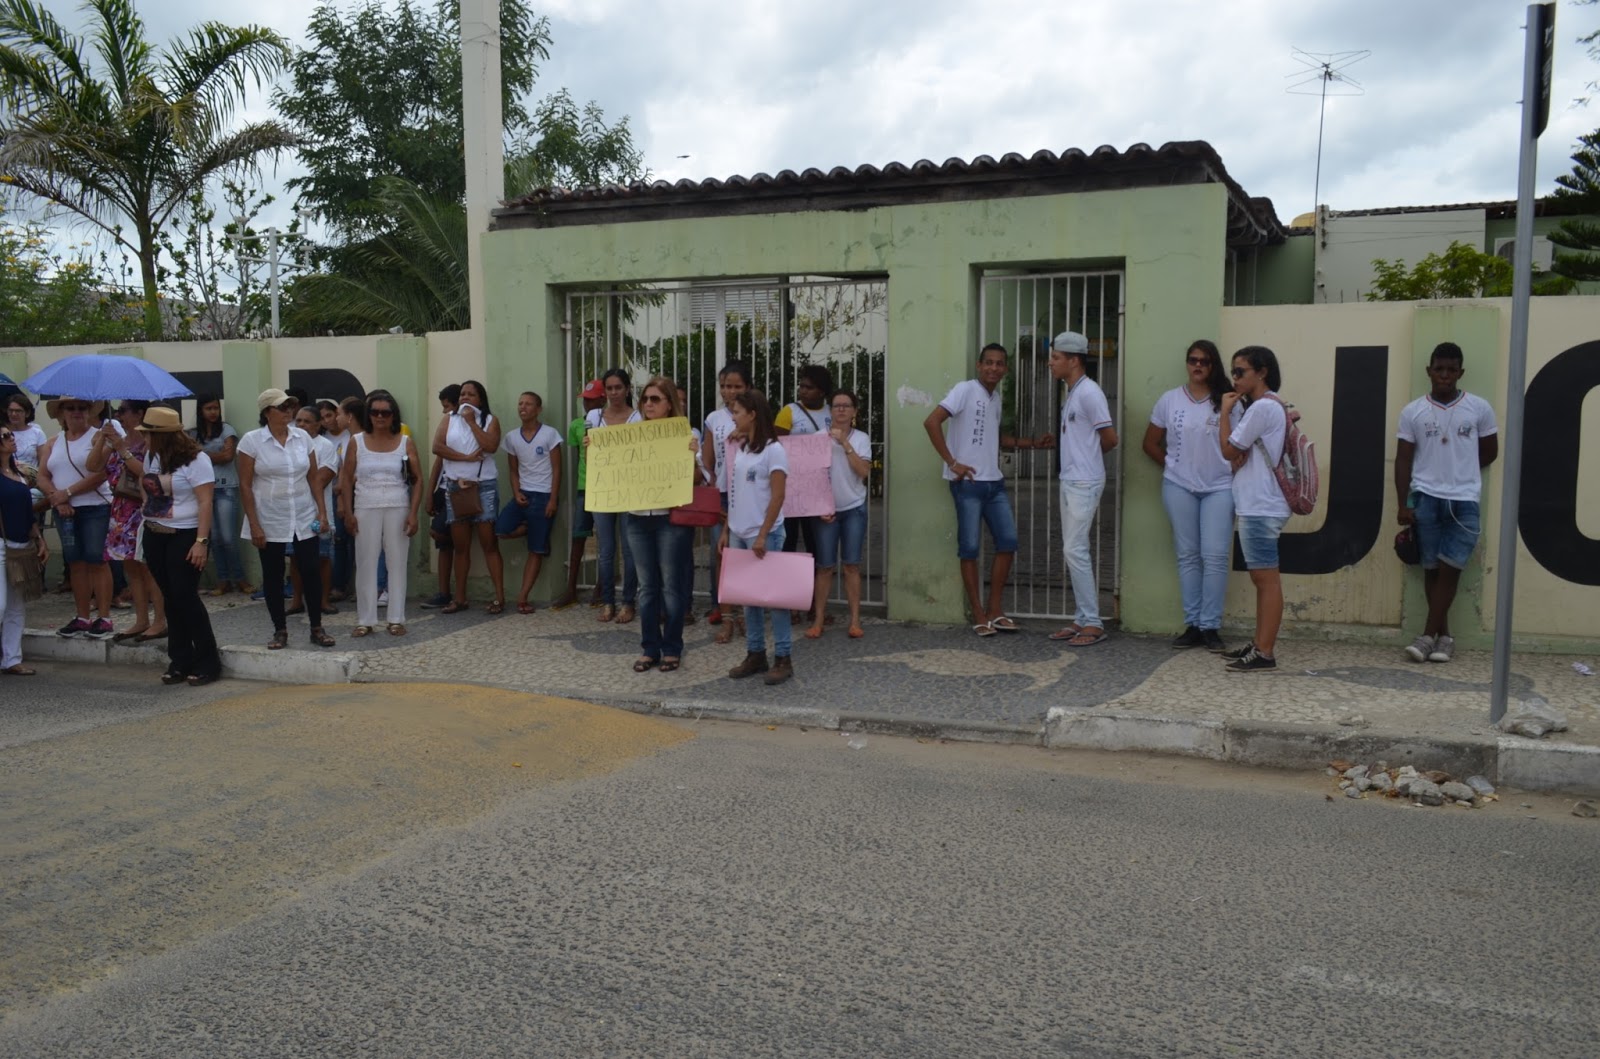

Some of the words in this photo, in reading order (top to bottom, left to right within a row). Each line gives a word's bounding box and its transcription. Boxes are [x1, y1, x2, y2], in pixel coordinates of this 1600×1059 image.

[972, 400, 982, 445] CETEP
[592, 427, 638, 451] QUANDO
[638, 426, 647, 442] A
[594, 450, 617, 467] SE
[622, 445, 658, 464] CALA
[595, 471, 605, 487] A
[612, 458, 691, 486] IMPUNIDADE
[592, 487, 630, 508] TEM
